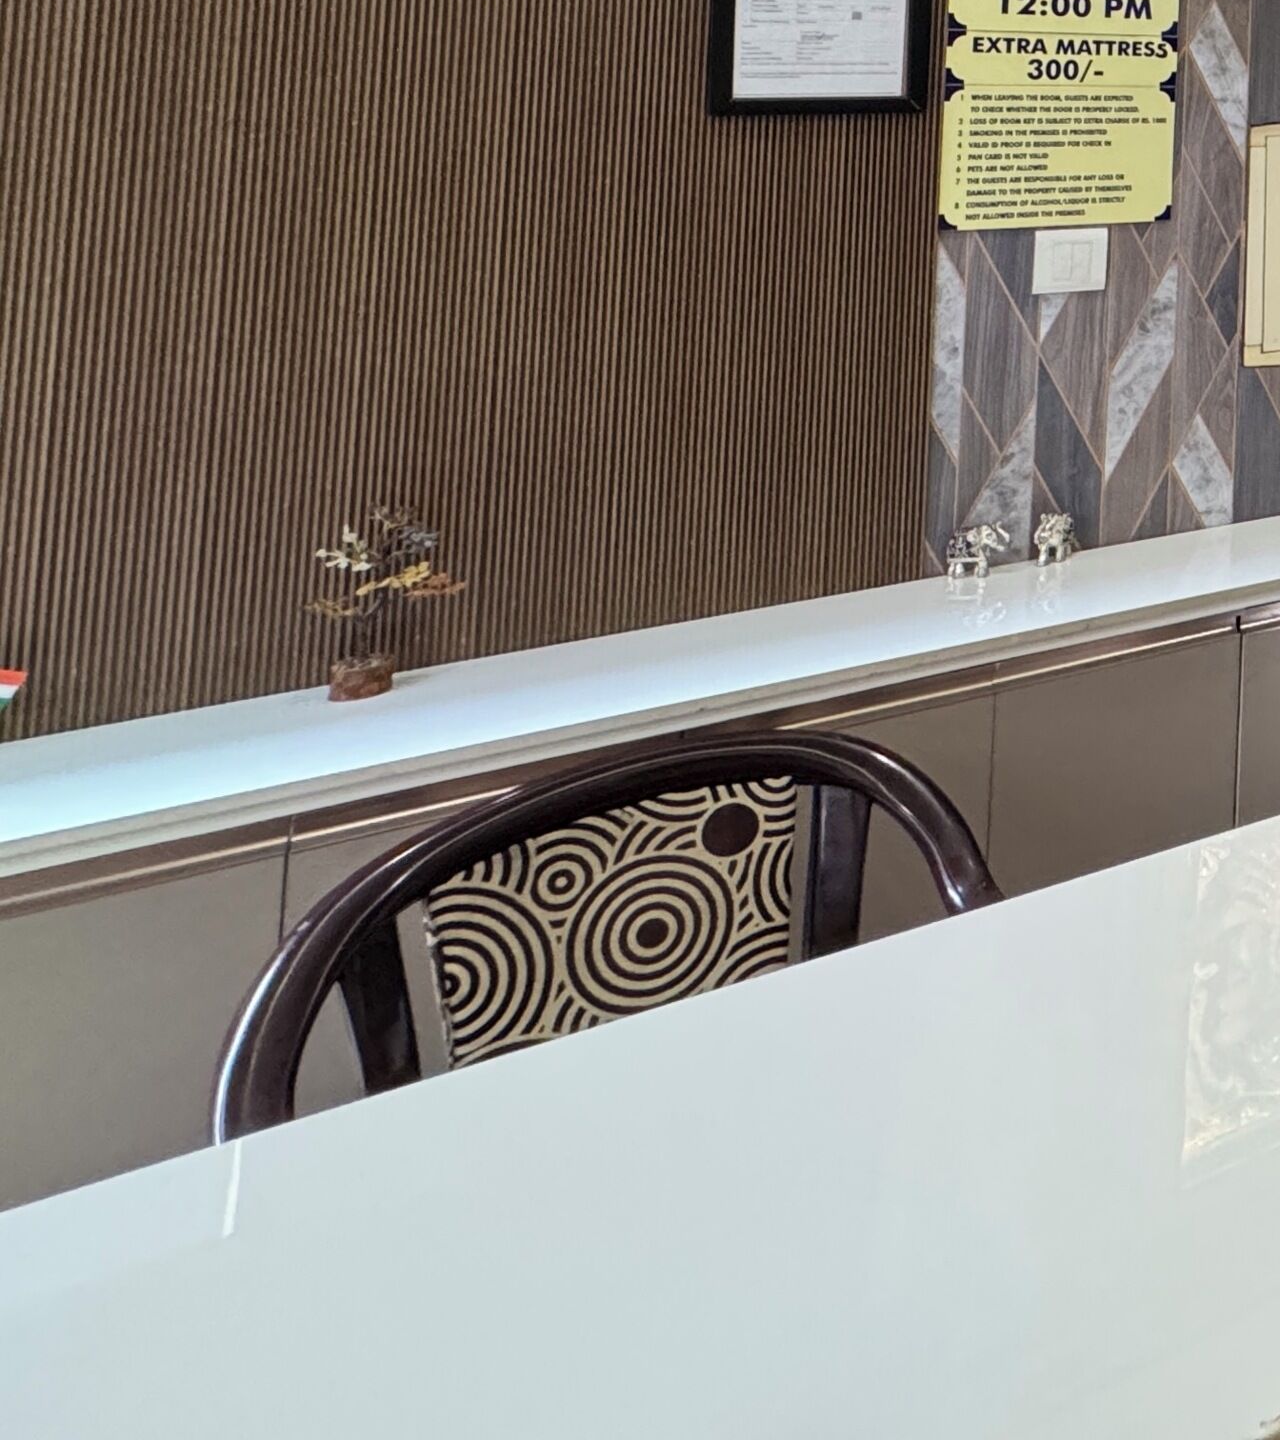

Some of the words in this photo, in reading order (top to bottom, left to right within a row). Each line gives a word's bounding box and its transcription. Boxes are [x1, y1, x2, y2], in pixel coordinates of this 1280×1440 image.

[972, 37, 1047, 54] EXTRA
[1056, 39, 1168, 58] MATTRESS
[1027, 59, 1104, 82] 300/-
